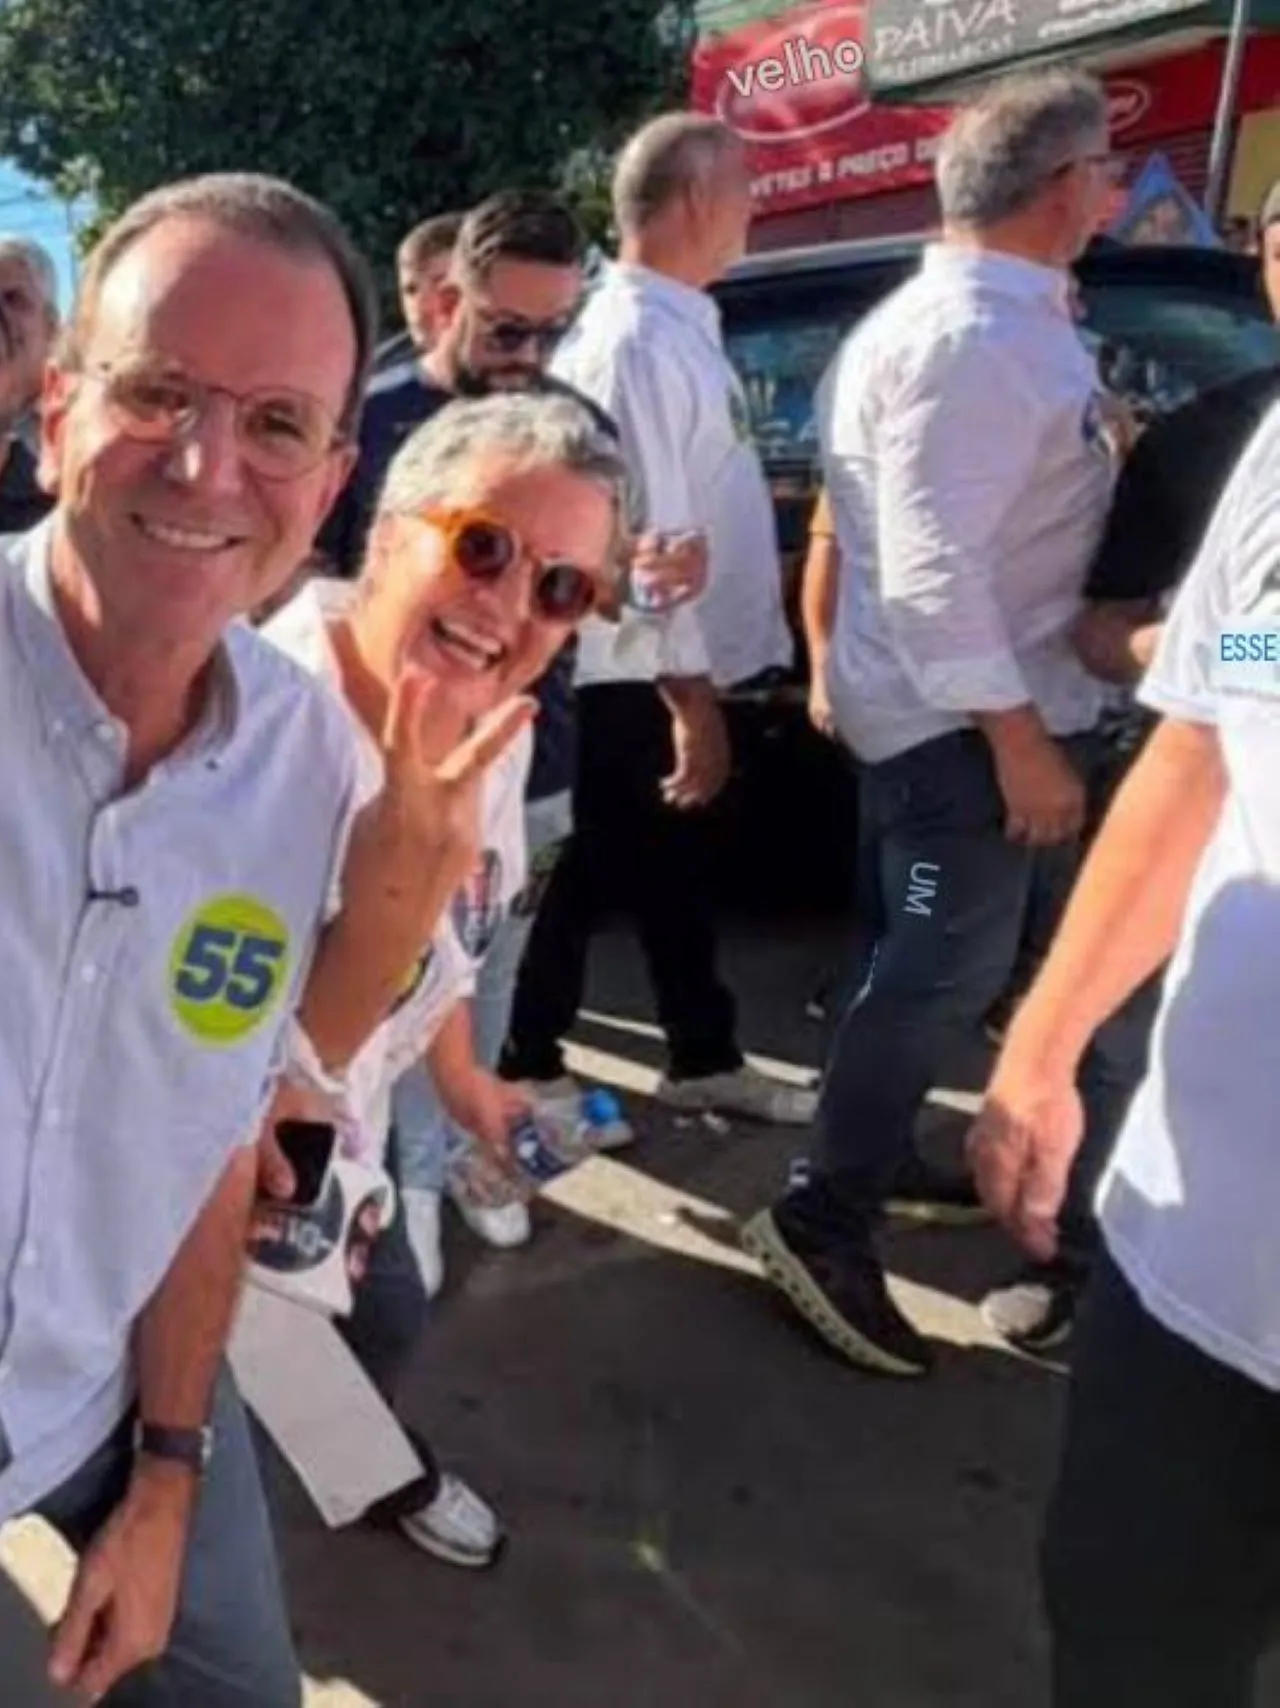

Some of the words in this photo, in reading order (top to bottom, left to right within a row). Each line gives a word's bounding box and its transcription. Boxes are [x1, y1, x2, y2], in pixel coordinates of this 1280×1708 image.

[874, 0, 1017, 59] PAIVA
[725, 36, 865, 98] velho
[1221, 633, 1278, 662] ESSE
[904, 862, 941, 917] UM
[176, 925, 286, 1009] 55
